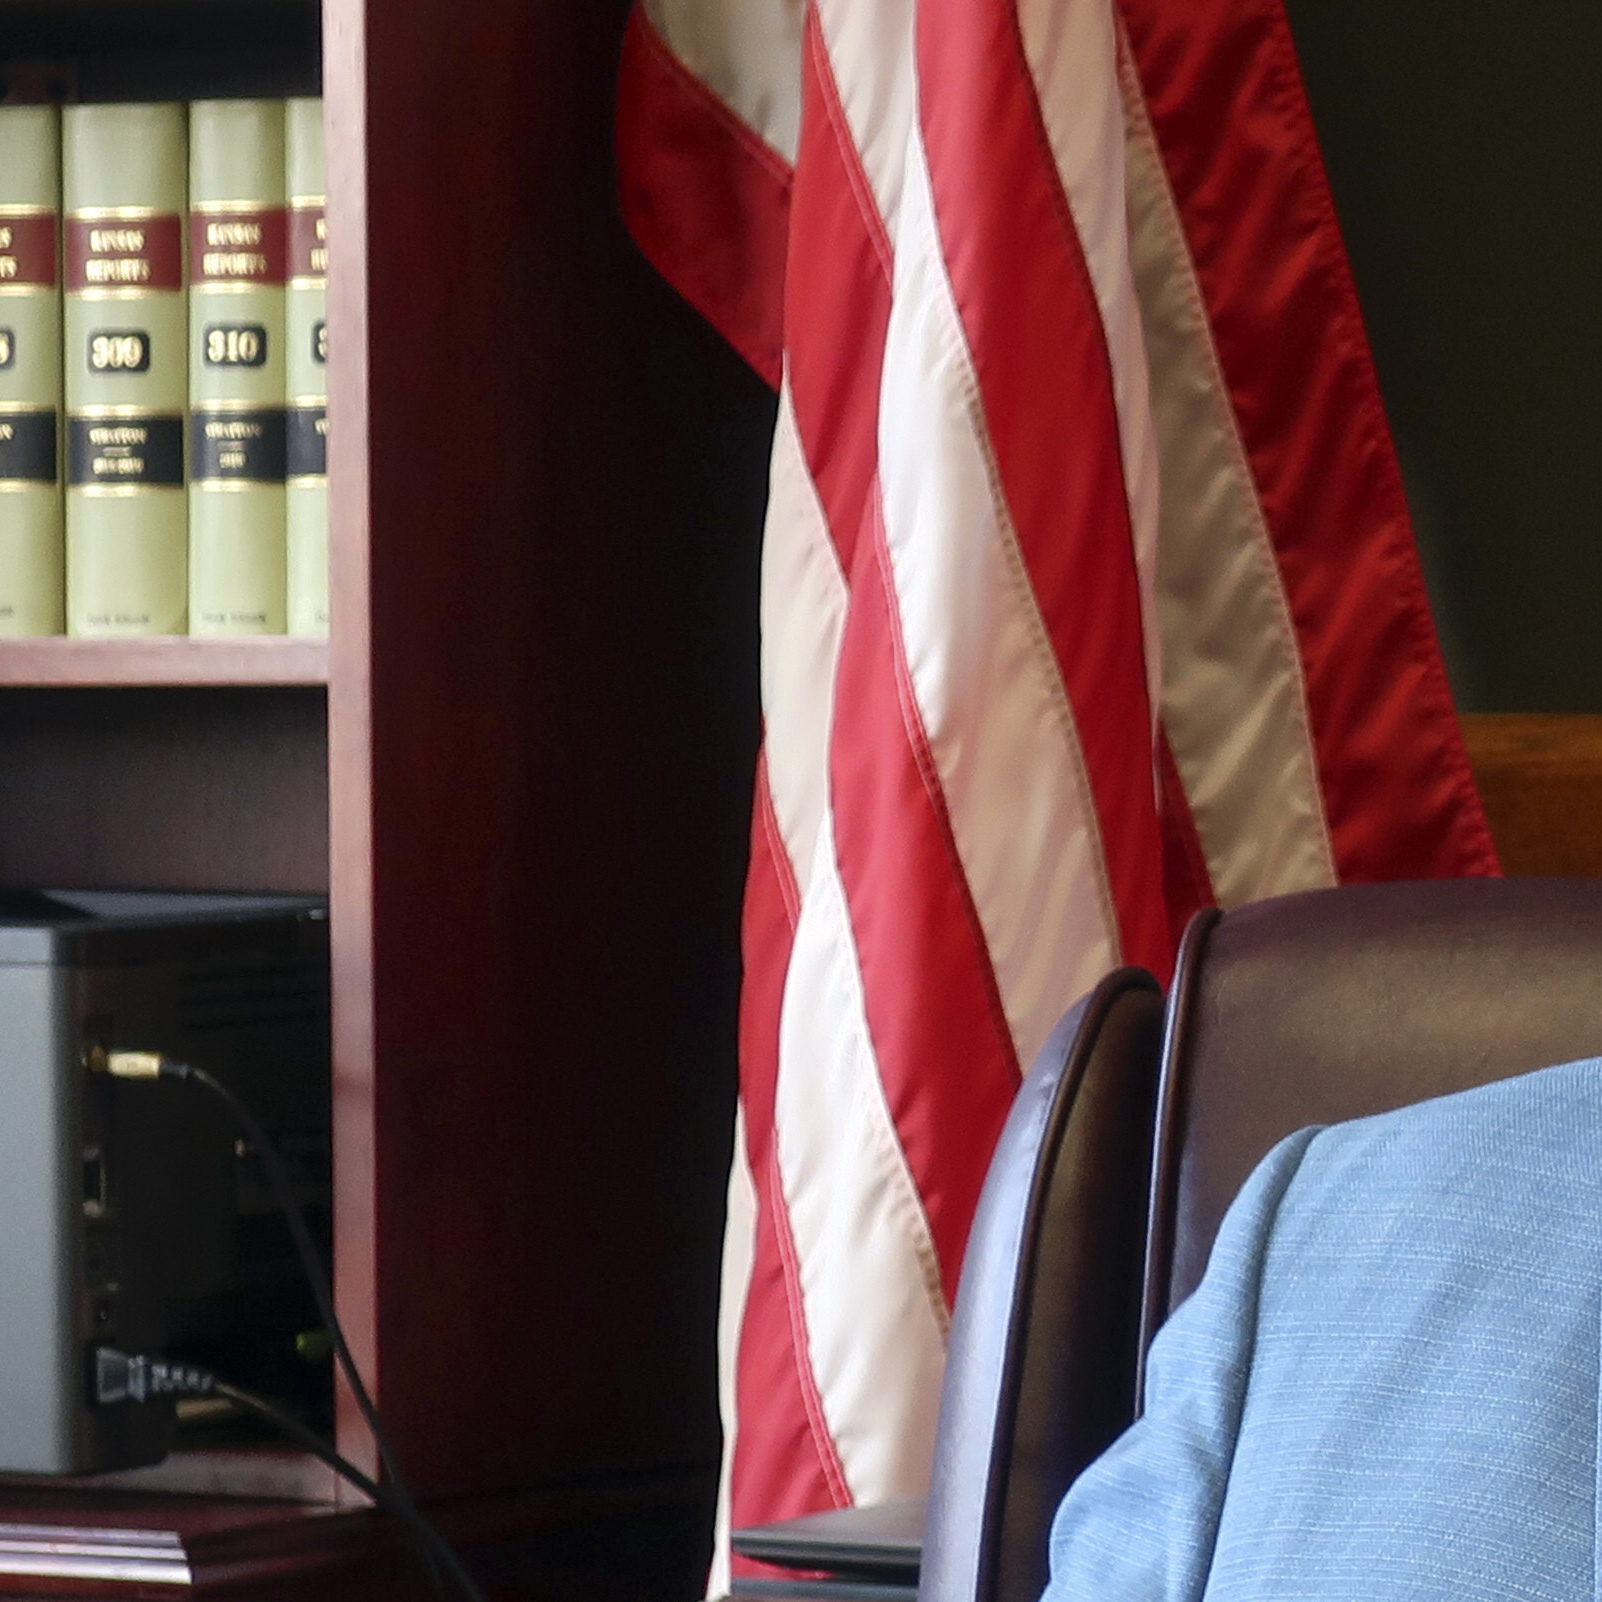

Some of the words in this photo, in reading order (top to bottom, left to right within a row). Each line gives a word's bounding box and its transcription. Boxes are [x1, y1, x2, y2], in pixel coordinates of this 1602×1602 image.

[90, 228, 145, 252] KANSAS
[207, 222, 261, 246] KANSAS
[85, 258, 150, 282] REPORTS
[203, 252, 267, 275] REPORTS
[207, 330, 259, 362] 310
